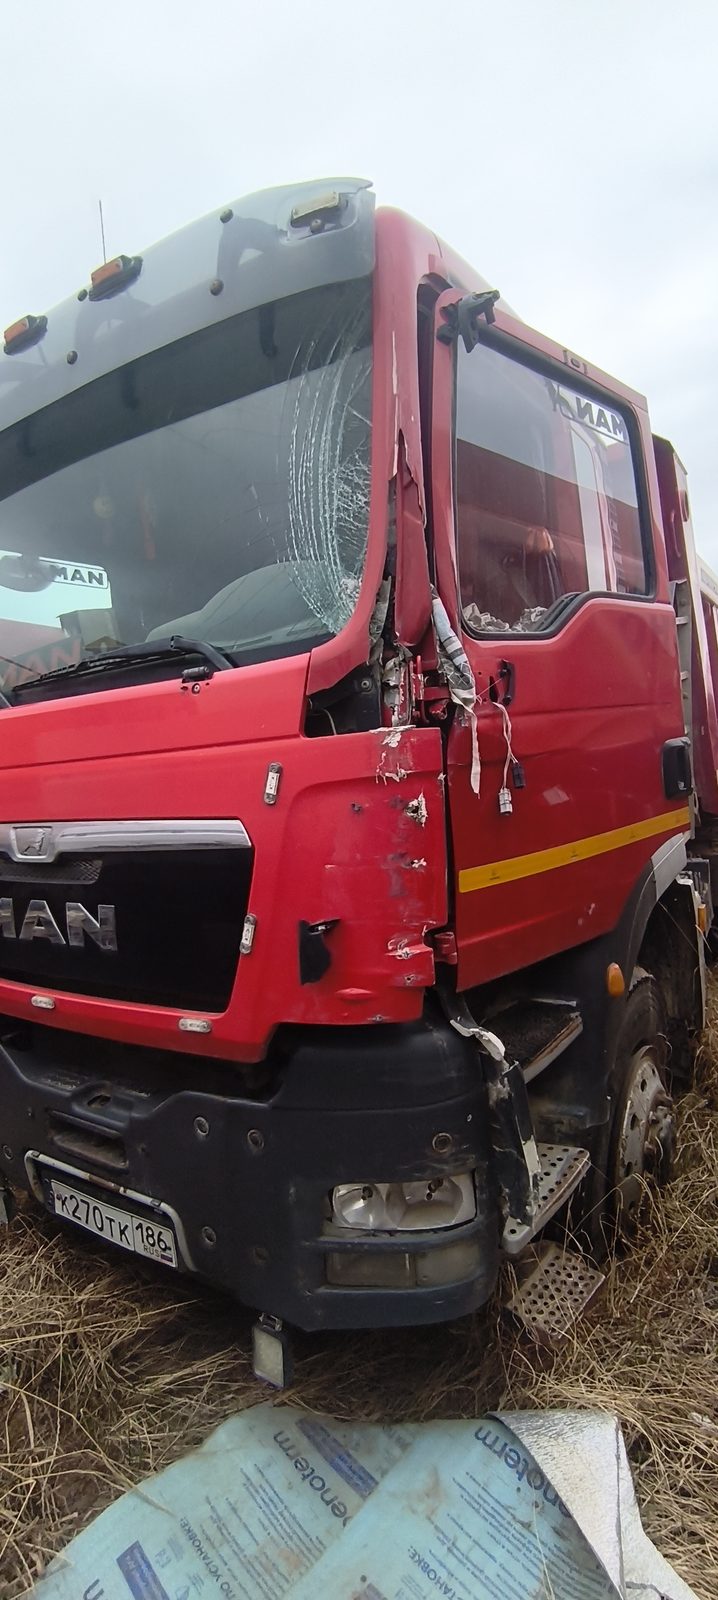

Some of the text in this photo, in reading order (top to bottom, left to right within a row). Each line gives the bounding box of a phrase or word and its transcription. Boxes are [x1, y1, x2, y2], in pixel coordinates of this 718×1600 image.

[49, 564, 104, 586] MAN
[135, 1222, 168, 1252] 186
[143, 1244, 161, 1258] RUS
